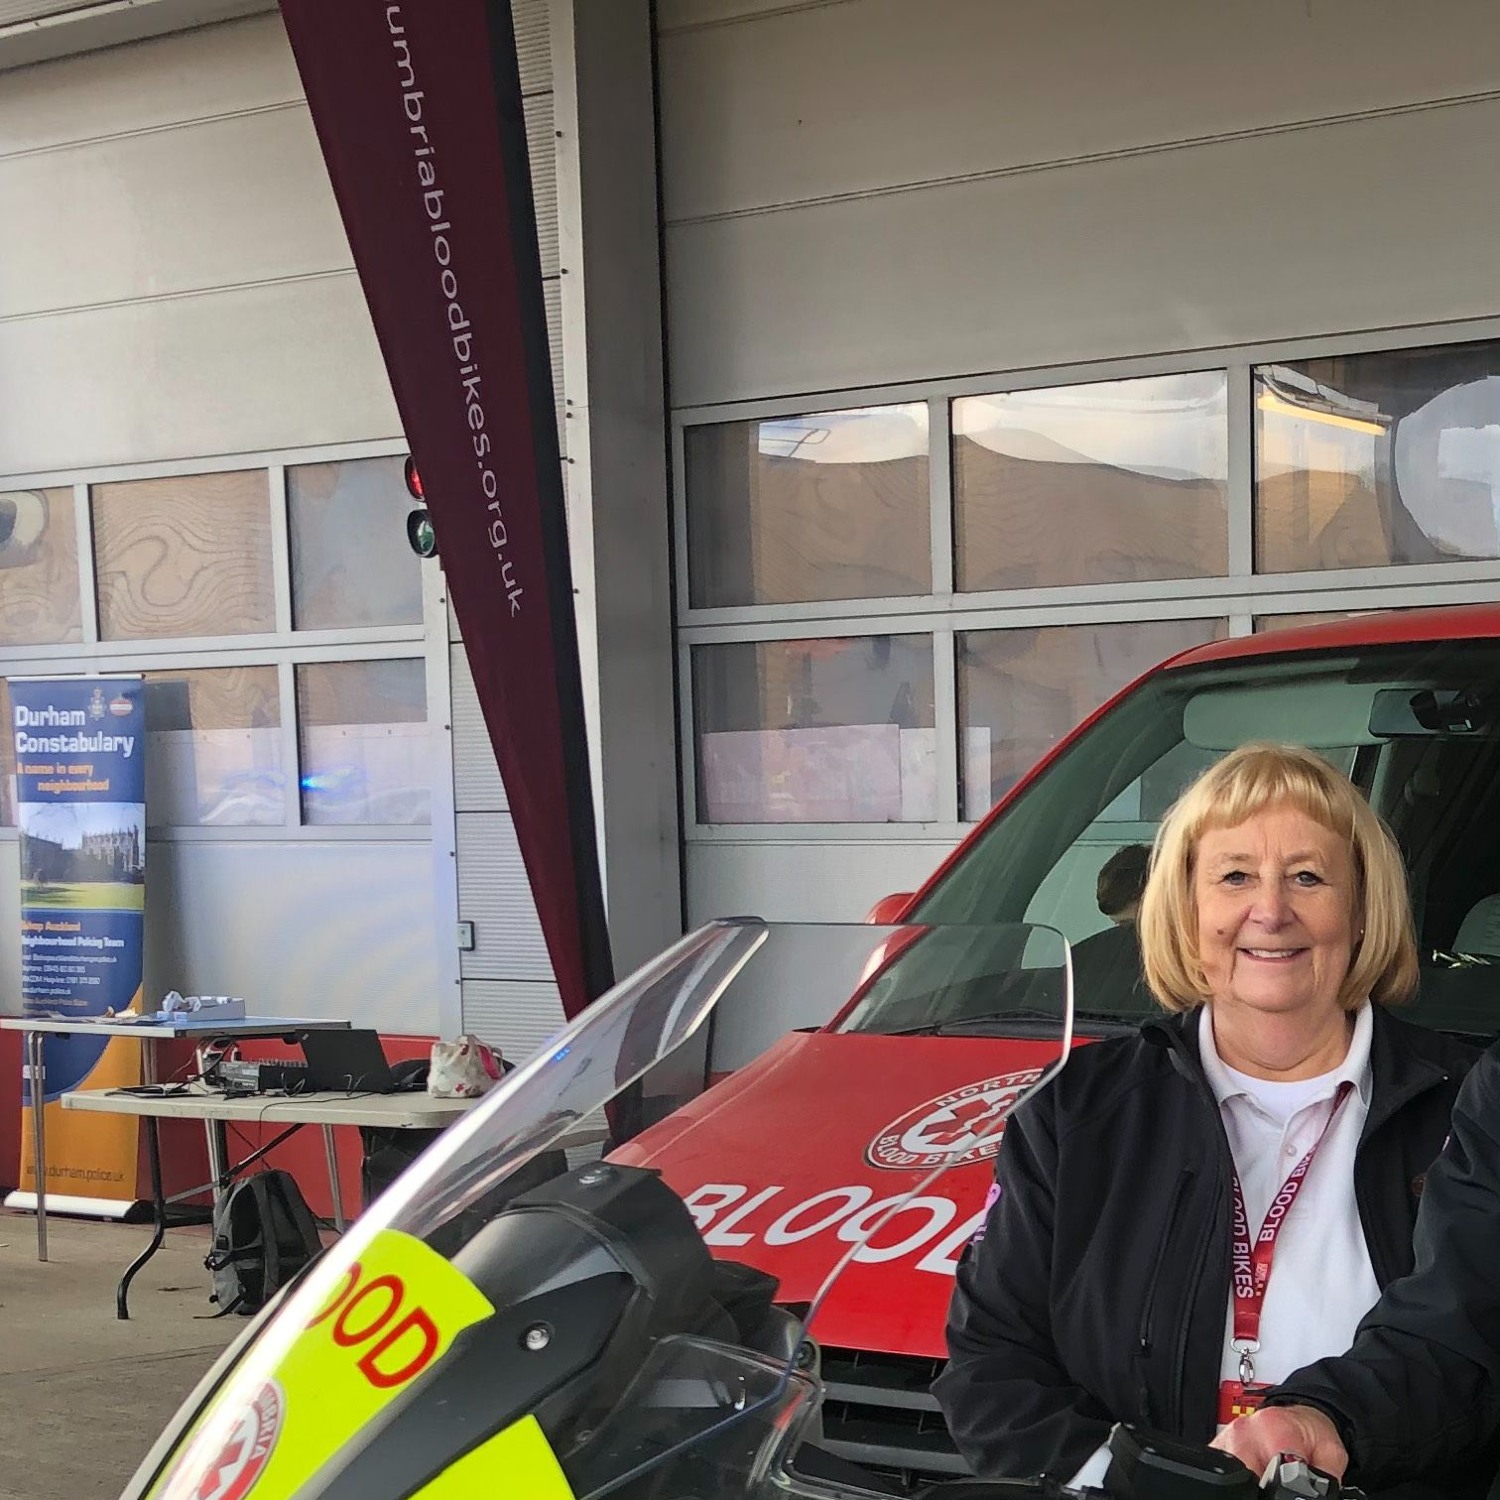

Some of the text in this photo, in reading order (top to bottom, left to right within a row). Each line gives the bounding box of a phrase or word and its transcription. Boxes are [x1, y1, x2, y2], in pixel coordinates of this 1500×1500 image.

[386, 0, 523, 617] umbriabloodbikes.org.uk
[15, 705, 85, 726] Durham
[16, 731, 134, 758] Constabulary
[877, 1134, 1003, 1165] BLOOD BIKE
[1260, 1181, 1298, 1241] BLOOD
[1233, 1241, 1254, 1299] BIKES
